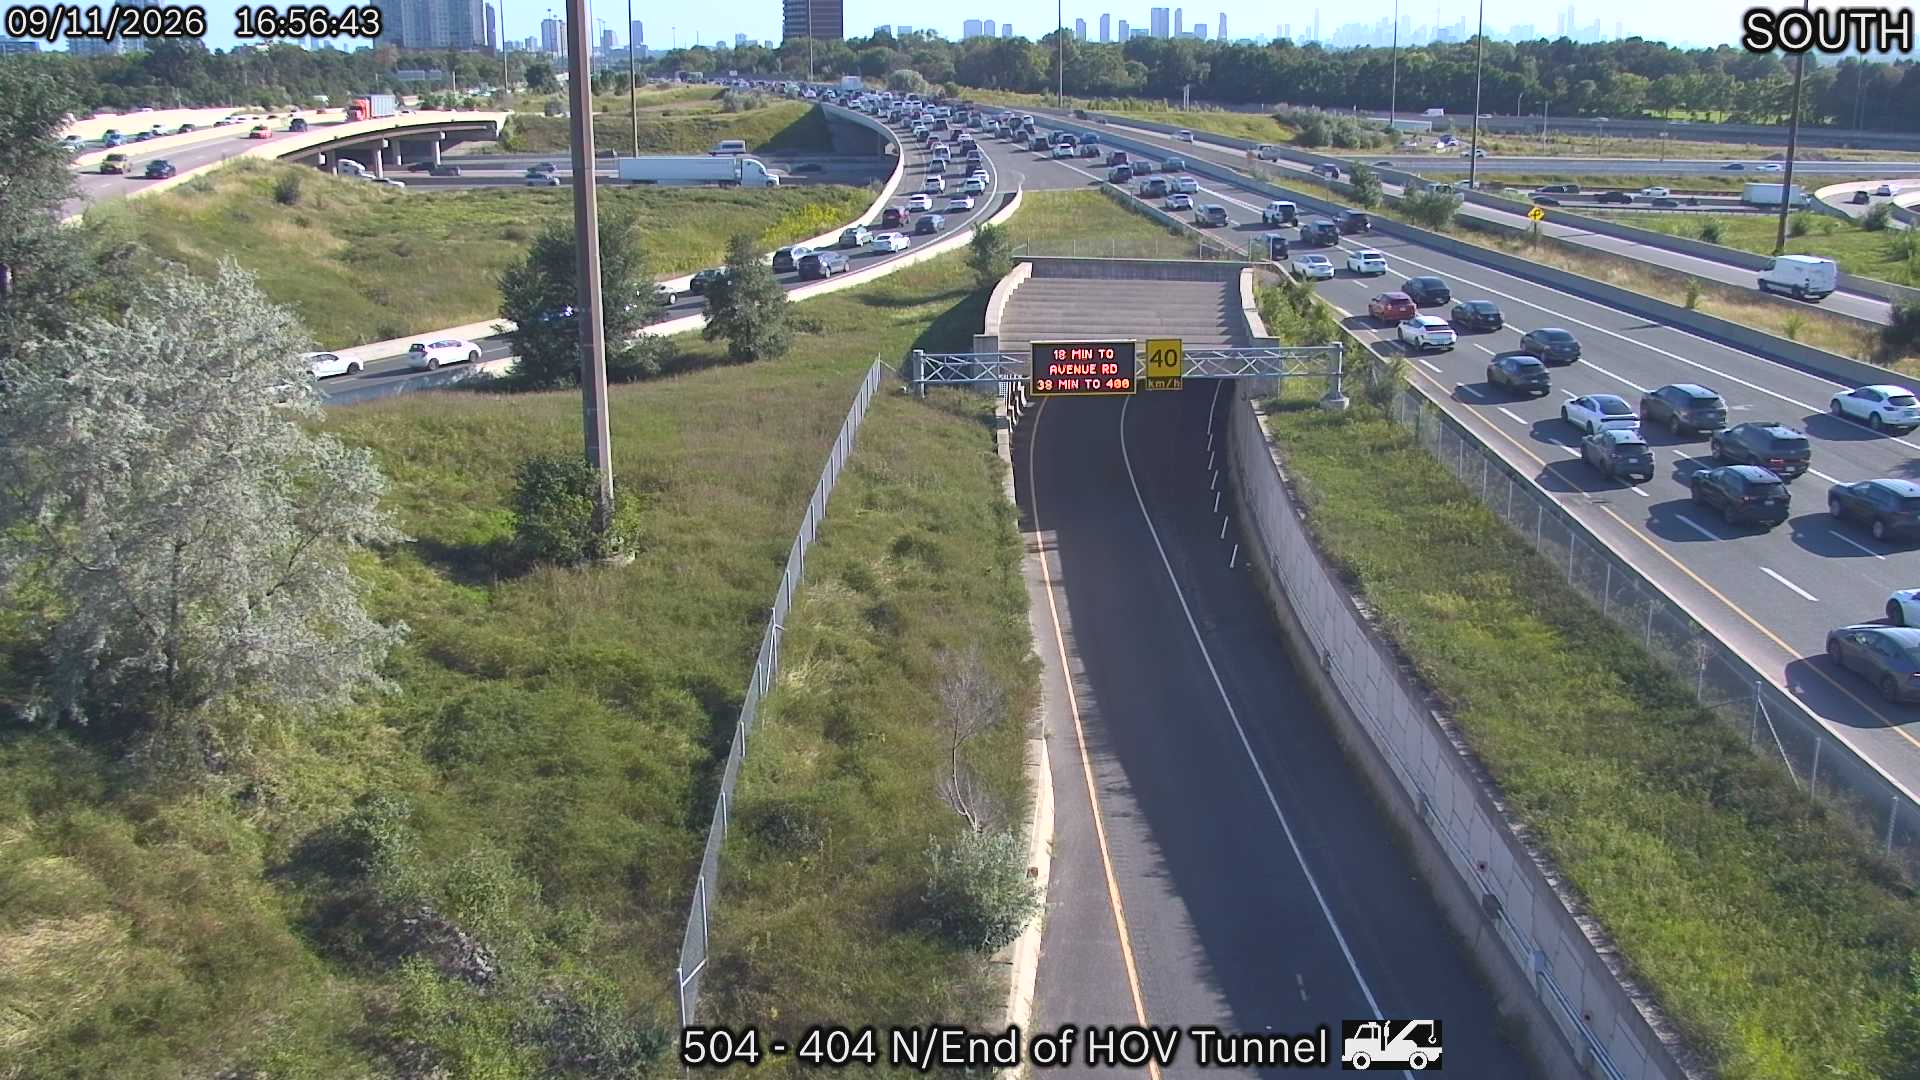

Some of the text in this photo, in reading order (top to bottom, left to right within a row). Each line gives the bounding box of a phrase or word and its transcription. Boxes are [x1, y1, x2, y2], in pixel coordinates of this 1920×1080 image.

[1071, 349, 1093, 360] MIN
[1098, 349, 1114, 359] TO
[1150, 349, 1177, 368] 40
[1049, 364, 1118, 375] AVENUE RD
[1037, 379, 1130, 391] 38 MIN TO 400
[1148, 379, 1181, 389] km/h
